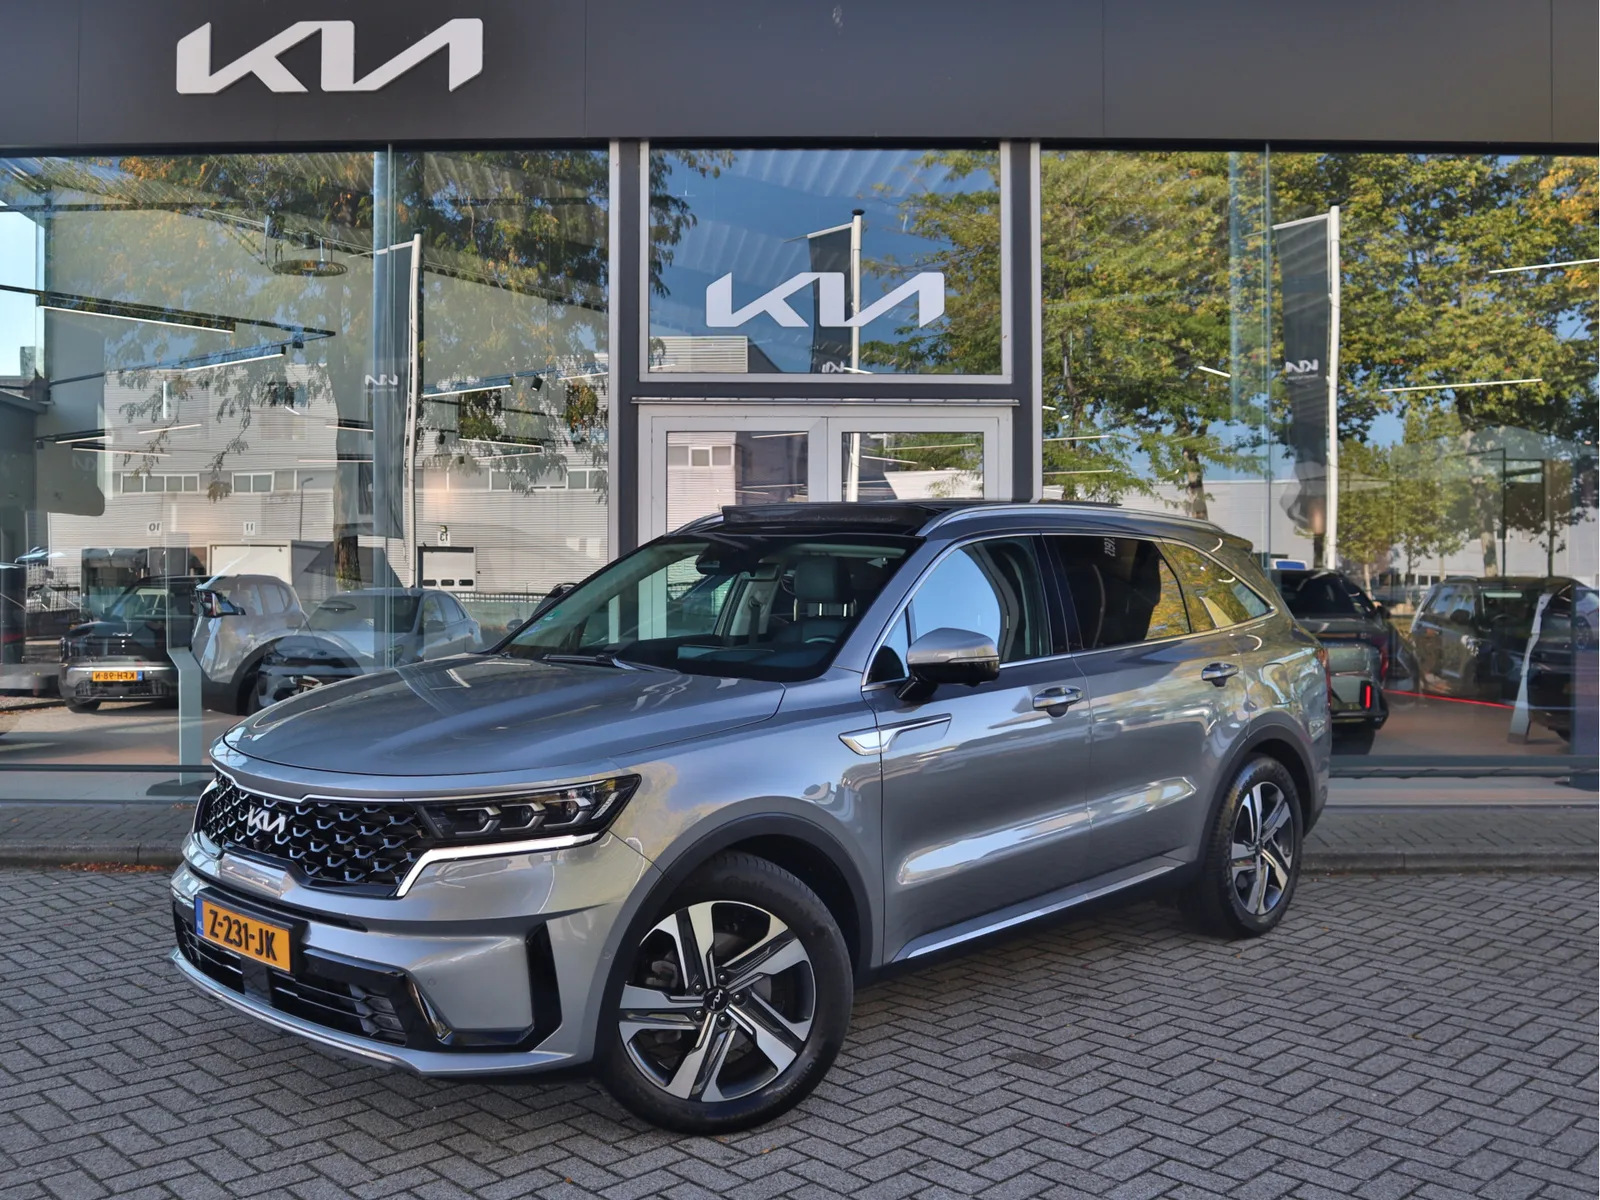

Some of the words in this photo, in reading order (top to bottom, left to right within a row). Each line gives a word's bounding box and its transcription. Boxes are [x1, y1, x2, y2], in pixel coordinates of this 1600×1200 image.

[176, 18, 483, 94] KIA
[706, 272, 944, 328] KIA
[247, 804, 286, 834] KIA
[208, 908, 278, 962] Z-231-JK
